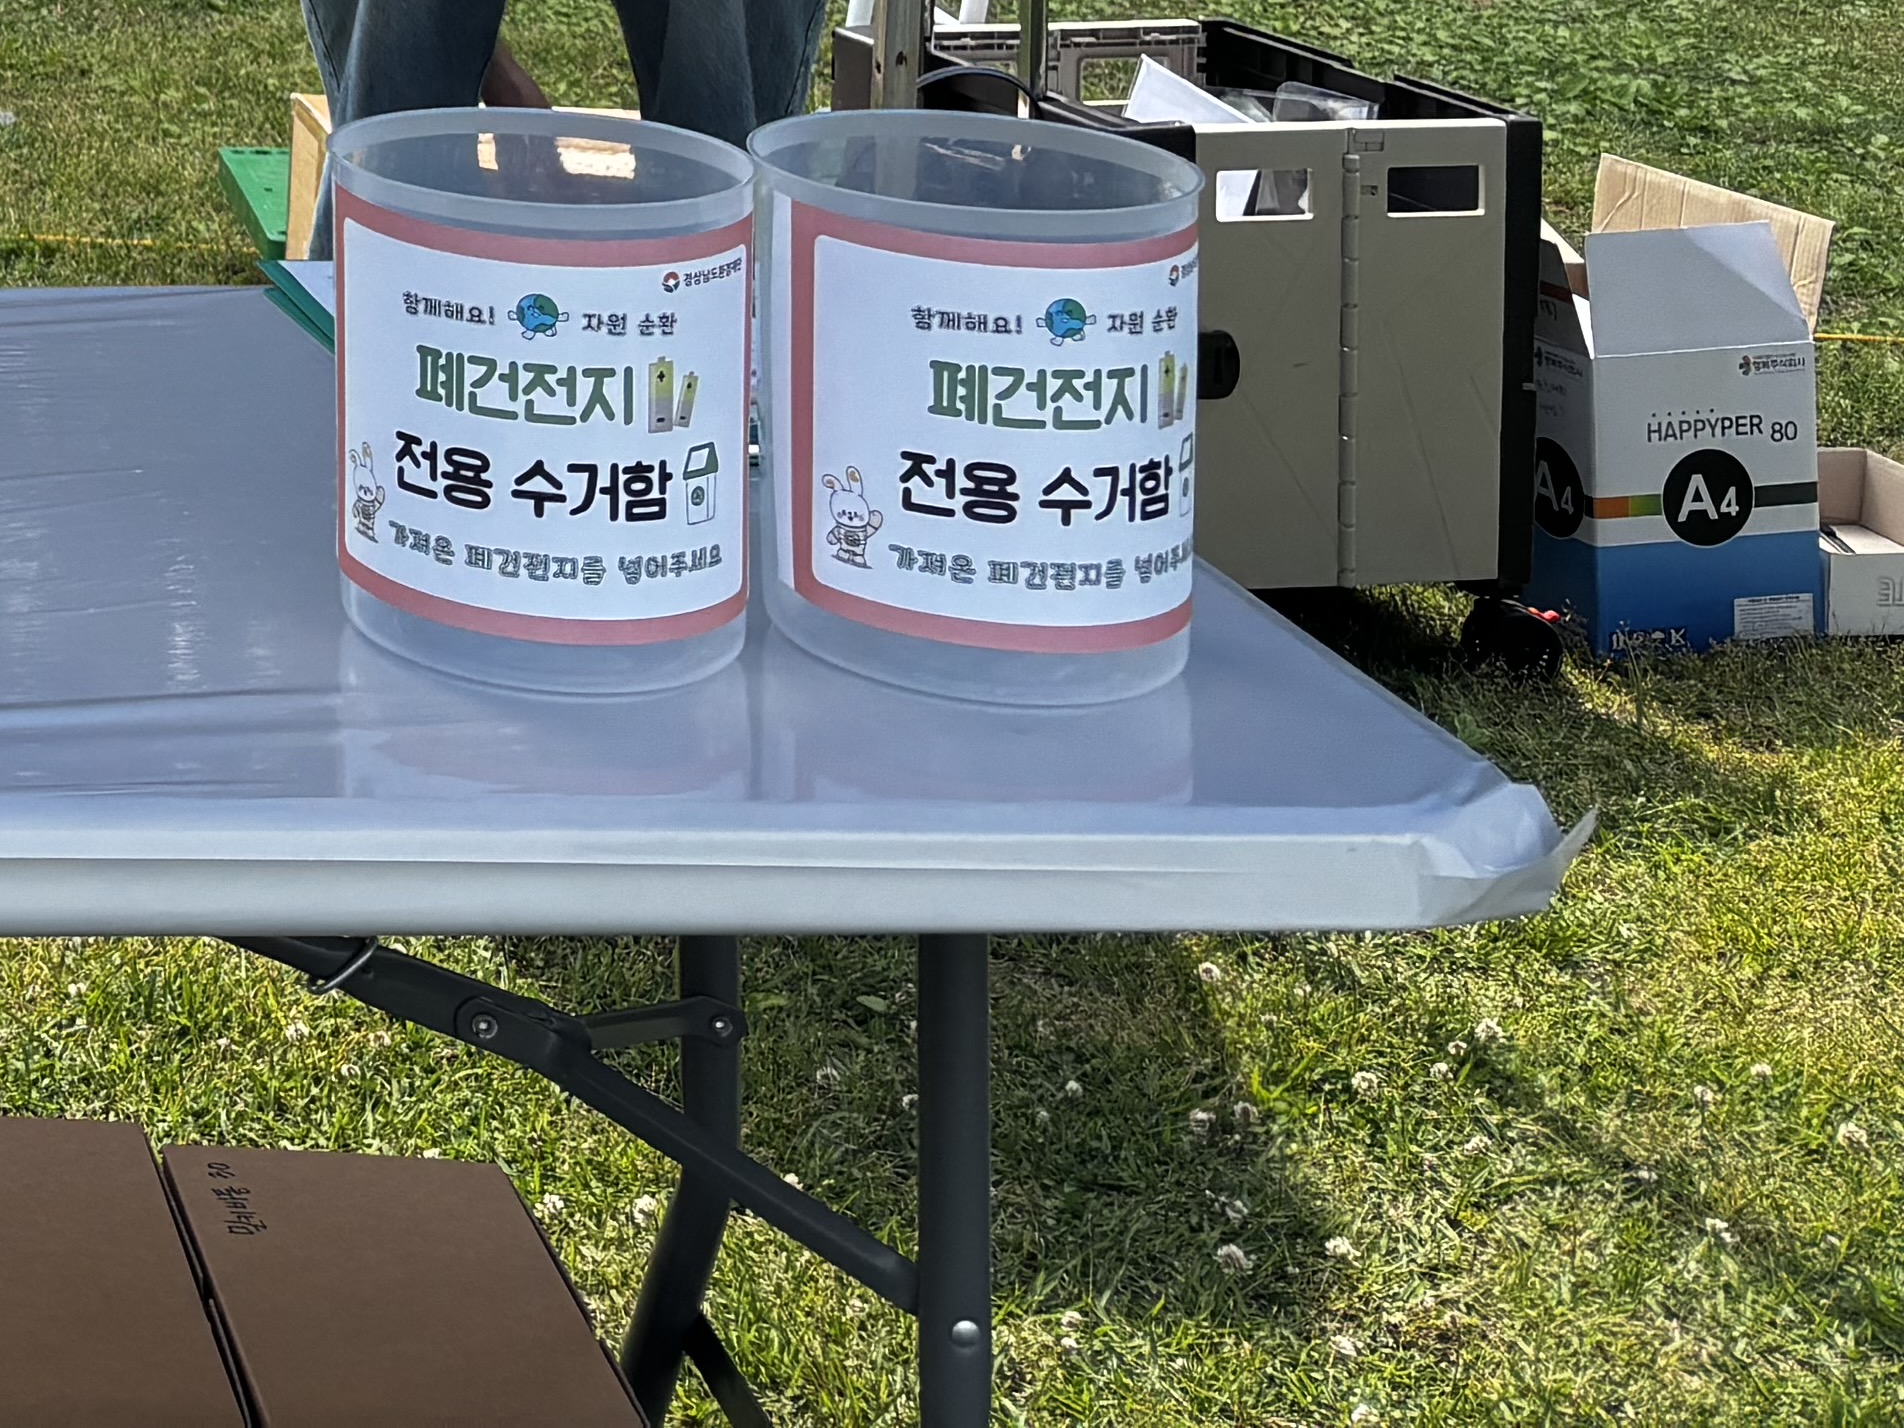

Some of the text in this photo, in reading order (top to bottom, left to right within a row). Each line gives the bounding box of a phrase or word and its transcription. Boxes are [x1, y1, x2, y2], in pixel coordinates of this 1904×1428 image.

[402, 291, 678, 337] 함께해요! 자원 순환
[911, 305, 1178, 335] 함께해요! 자원 순환
[414, 345, 636, 429] 폐건전지
[927, 358, 1150, 432] 폐건전지
[1647, 414, 1798, 443] HAPPYPER 80
[393, 429, 675, 523] 전용 수거함
[897, 450, 1173, 526] 전용 수거함
[1677, 474, 1740, 523] A4
[388, 520, 456, 566] 가져온
[888, 543, 976, 584] 가져온
